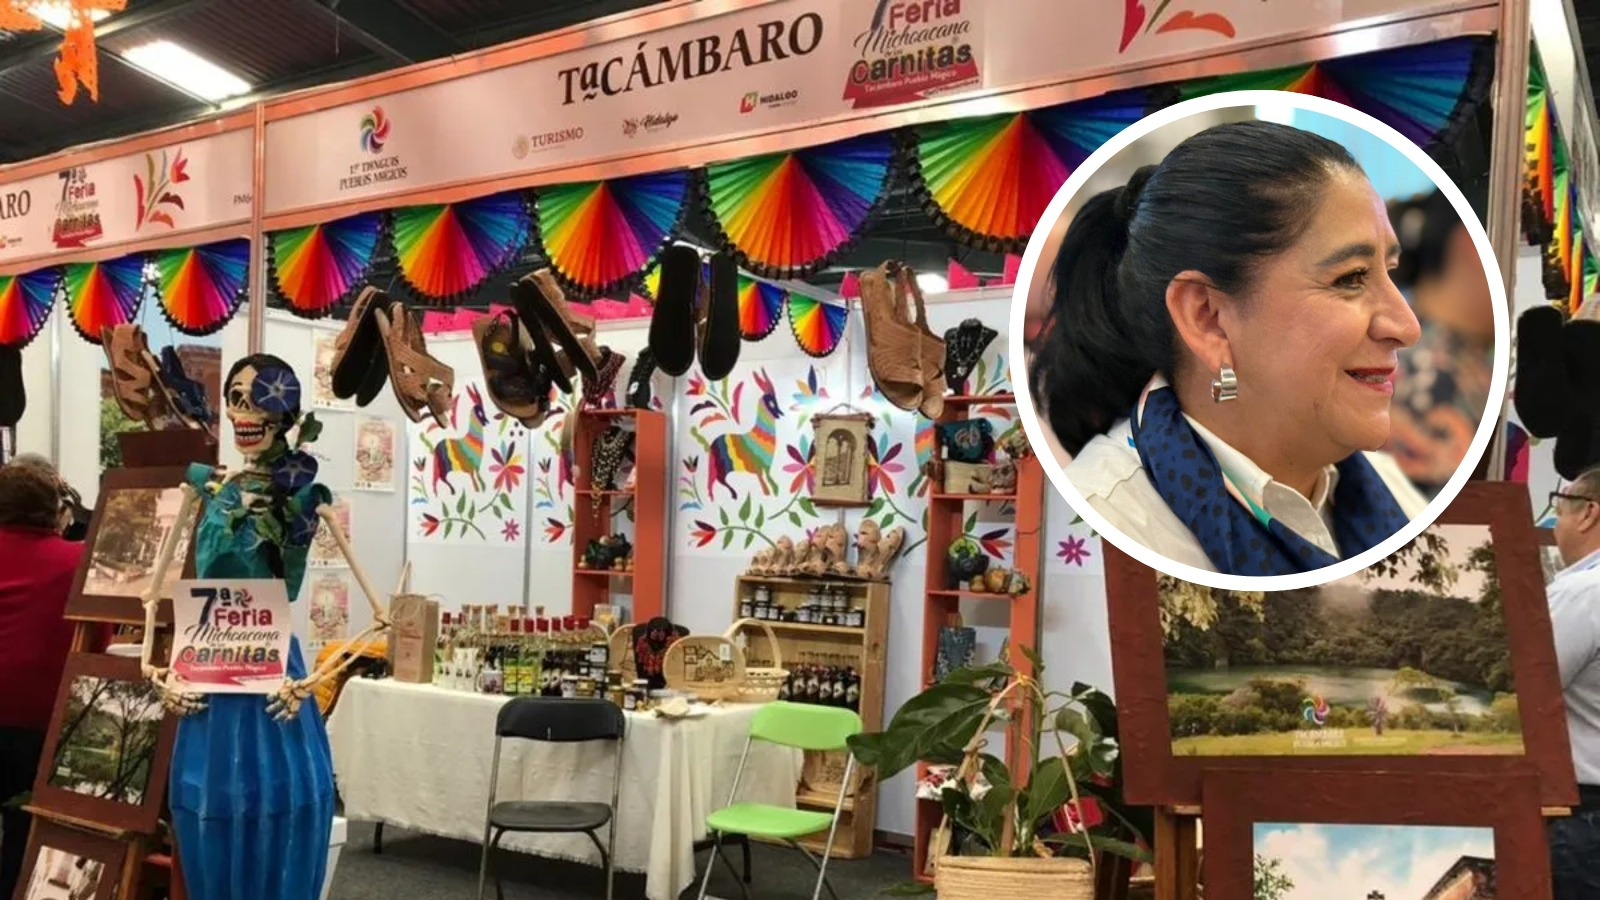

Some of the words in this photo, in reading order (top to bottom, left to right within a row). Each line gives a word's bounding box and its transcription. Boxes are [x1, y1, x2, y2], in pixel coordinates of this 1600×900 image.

[888, 0, 962, 29] Feria
[853, 20, 971, 58] Michoacana
[851, 43, 972, 85] Carnitas
[531, 126, 584, 148] TURISMO
[214, 608, 273, 627] Feria
[184, 622, 280, 645] Michoacana
[181, 645, 280, 664] Carnitas
